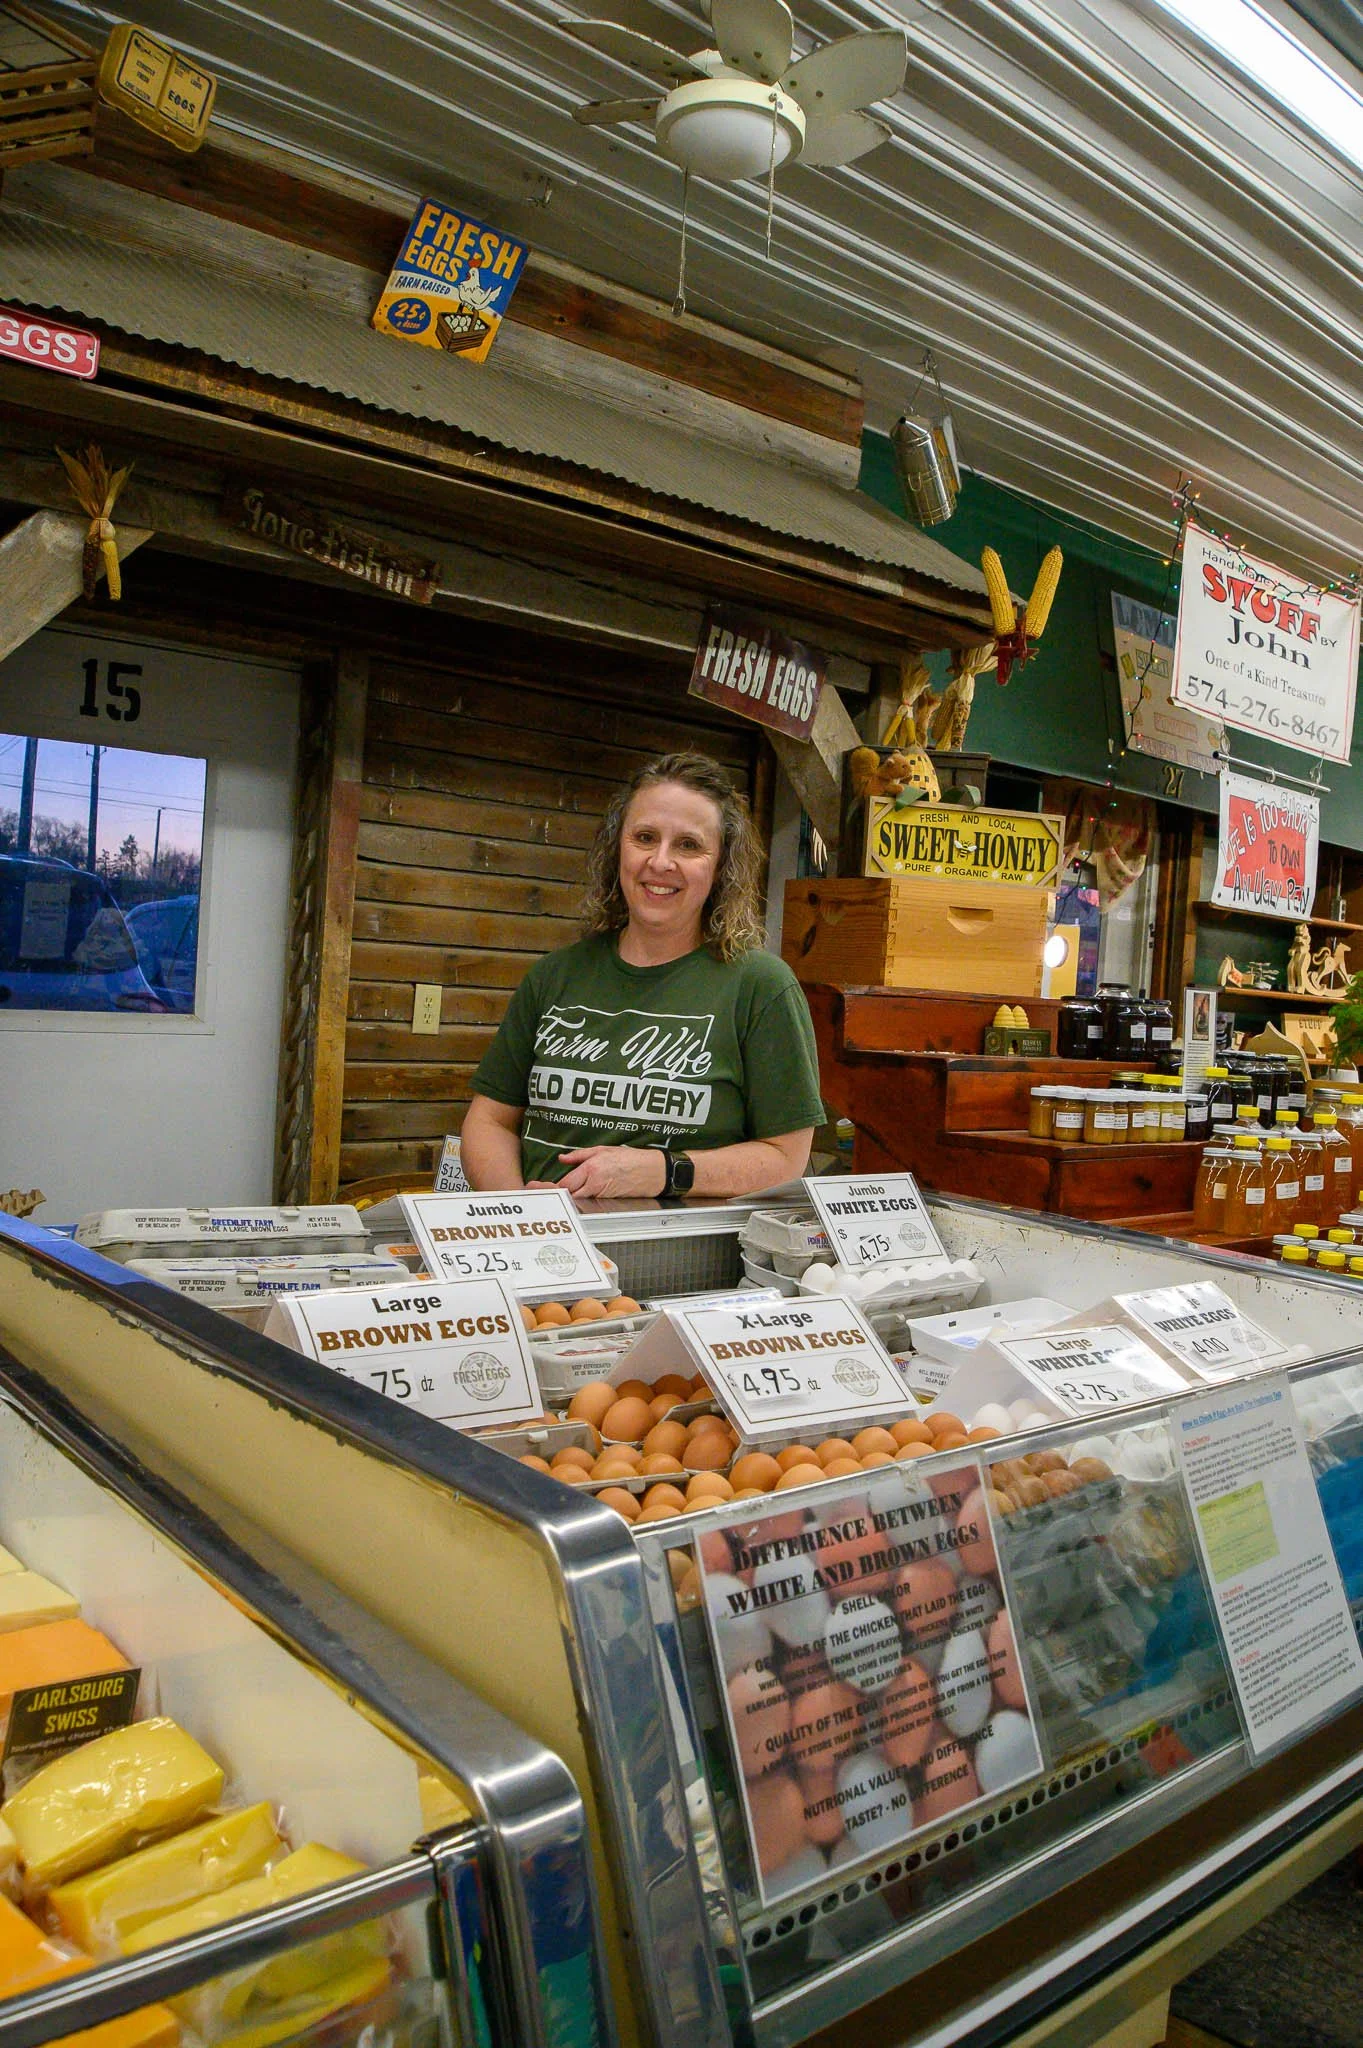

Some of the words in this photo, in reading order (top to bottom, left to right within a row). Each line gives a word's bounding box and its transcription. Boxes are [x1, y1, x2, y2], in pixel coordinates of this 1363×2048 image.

[168, 90, 196, 114] EGGS
[414, 203, 522, 280] FRESH
[404, 238, 463, 283] EGGS
[395, 276, 421, 290] FARM
[421, 279, 451, 295] RAISED
[394, 302, 427, 321] 25¢
[0, 314, 77, 363] GGS
[1202, 547, 1273, 587] Hand-Made
[1202, 563, 1322, 644] STUFF
[1320, 635, 1338, 648] BY
[1226, 614, 1312, 670] John
[701, 624, 772, 700] FRESH
[767, 654, 817, 722] EGGS
[1205, 650, 1230, 671] One
[1233, 661, 1246, 677] of
[1247, 668, 1253, 679] a
[1254, 666, 1279, 691] Kind
[1280, 678, 1327, 706] Treasures
[80, 658, 143, 722] 15
[1185, 675, 1340, 749] 574-276-8467
[919, 813, 950, 823] FRESH
[961, 815, 980, 825] AND
[988, 817, 1017, 833] LOCAL
[1220, 828, 1246, 872] LIFE
[1243, 812, 1257, 846] IS
[1255, 797, 1279, 836] TOO
[1280, 791, 1318, 840] SHORT
[878, 820, 960, 865] SWEET
[971, 831, 1052, 874] HONEY
[1268, 839, 1277, 865] TO
[1280, 842, 1300, 869] OWN
[904, 863, 932, 873] PURE
[944, 866, 989, 879] ORGANIC
[1001, 872, 1024, 882] RAW
[1233, 864, 1251, 902] AN
[1254, 867, 1283, 910] UGLY
[1286, 876, 1310, 915] PEN
[534, 1015, 610, 1063] Farm
[620, 1025, 712, 1080] Wife
[529, 1072, 564, 1101] ELD
[571, 1078, 705, 1118] DELIVERY
[550, 1112, 588, 1126] FARMERS
[592, 1118, 614, 1130] WHO
[615, 1121, 639, 1132] FEED
[642, 1124, 662, 1132] THE
[440, 1178, 470, 1193] Bush
[847, 1185, 886, 1197] Jumbo
[465, 1203, 523, 1217] Jumbo
[826, 1200, 880, 1216] WHITE
[882, 1198, 917, 1211] EGGS
[211, 1219, 252, 1227] GREENLIFE
[430, 1223, 515, 1242] BROWN
[517, 1220, 572, 1237] EGGS
[837, 1228, 848, 1240] $
[860, 1234, 890, 1262] 4.75
[512, 1259, 523, 1271] dz
[257, 1281, 299, 1290] GREENLIFE
[301, 1282, 321, 1290] FARM
[371, 1295, 442, 1314] Large
[317, 1323, 433, 1351] BROWN
[436, 1315, 511, 1339] EGGS
[736, 1312, 813, 1329] X-Large
[1154, 1315, 1205, 1333] WHITE
[1201, 1308, 1237, 1323] EGGS
[709, 1339, 806, 1360] BROWN
[806, 1329, 866, 1348] EGGS
[1046, 1339, 1093, 1351] Large
[453, 1370, 485, 1385] FRESH
[485, 1367, 511, 1380] EGGS
[1028, 1353, 1097, 1372] WHITE
[370, 1368, 411, 1399] 75
[421, 1376, 434, 1392] dz
[808, 1378, 821, 1391] dz
[733, 1517, 868, 1572] DIFFERENCE
[871, 1492, 963, 1534] BETWEEN
[725, 1572, 805, 1616] WHITE
[809, 1558, 854, 1590] AND
[857, 1536, 931, 1576] BROWN
[934, 1522, 980, 1553] EGGS
[812, 1637, 828, 1653] OF
[829, 1629, 850, 1647] THE
[851, 1613, 898, 1639] CHICKEN
[924, 1597, 947, 1615] LAID
[948, 1590, 966, 1606] THE
[966, 1584, 985, 1600] EGG
[841, 1594, 873, 1615] SHELL
[27, 1677, 125, 1713] JARLSBURG
[956, 1680, 975, 1694] FROM
[45, 1707, 99, 1735] SWISS
[764, 1721, 814, 1753] QUALITY
[815, 1714, 831, 1733] OF
[832, 1705, 854, 1726] THE
[950, 1667, 962, 1679] GET
[963, 1662, 975, 1673] THE
[802, 1781, 866, 1821] NUTRIONAL
[918, 1750, 934, 1768] NO
[935, 1724, 994, 1760] DIFFERENCE
[844, 1803, 884, 1833] TASTE?
[890, 1792, 907, 1811] NO
[908, 1763, 969, 1802] DIFFERENCE
